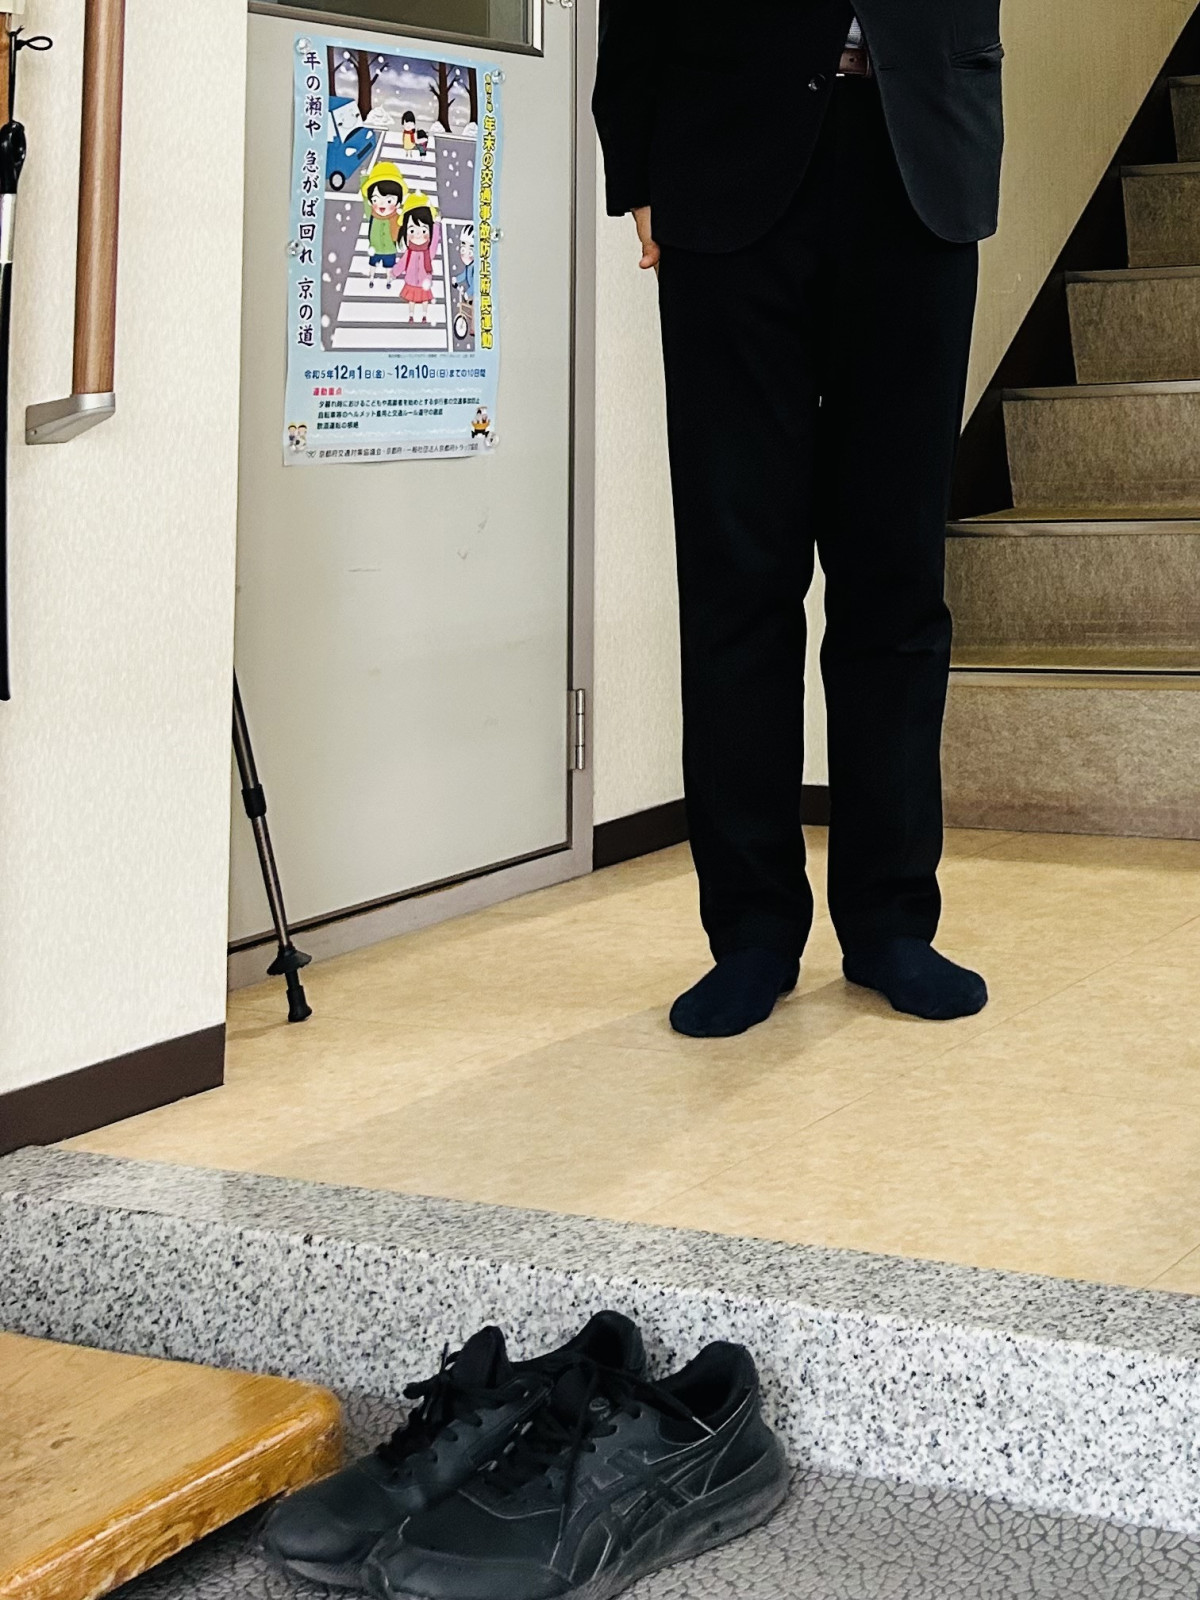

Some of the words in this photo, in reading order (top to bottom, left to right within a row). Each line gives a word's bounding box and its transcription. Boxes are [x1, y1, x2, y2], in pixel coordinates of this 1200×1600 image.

[303, 52, 322, 138] 年の瀬や
[299, 150, 320, 264] 急がば回れ
[297, 277, 315, 347] 京の道
